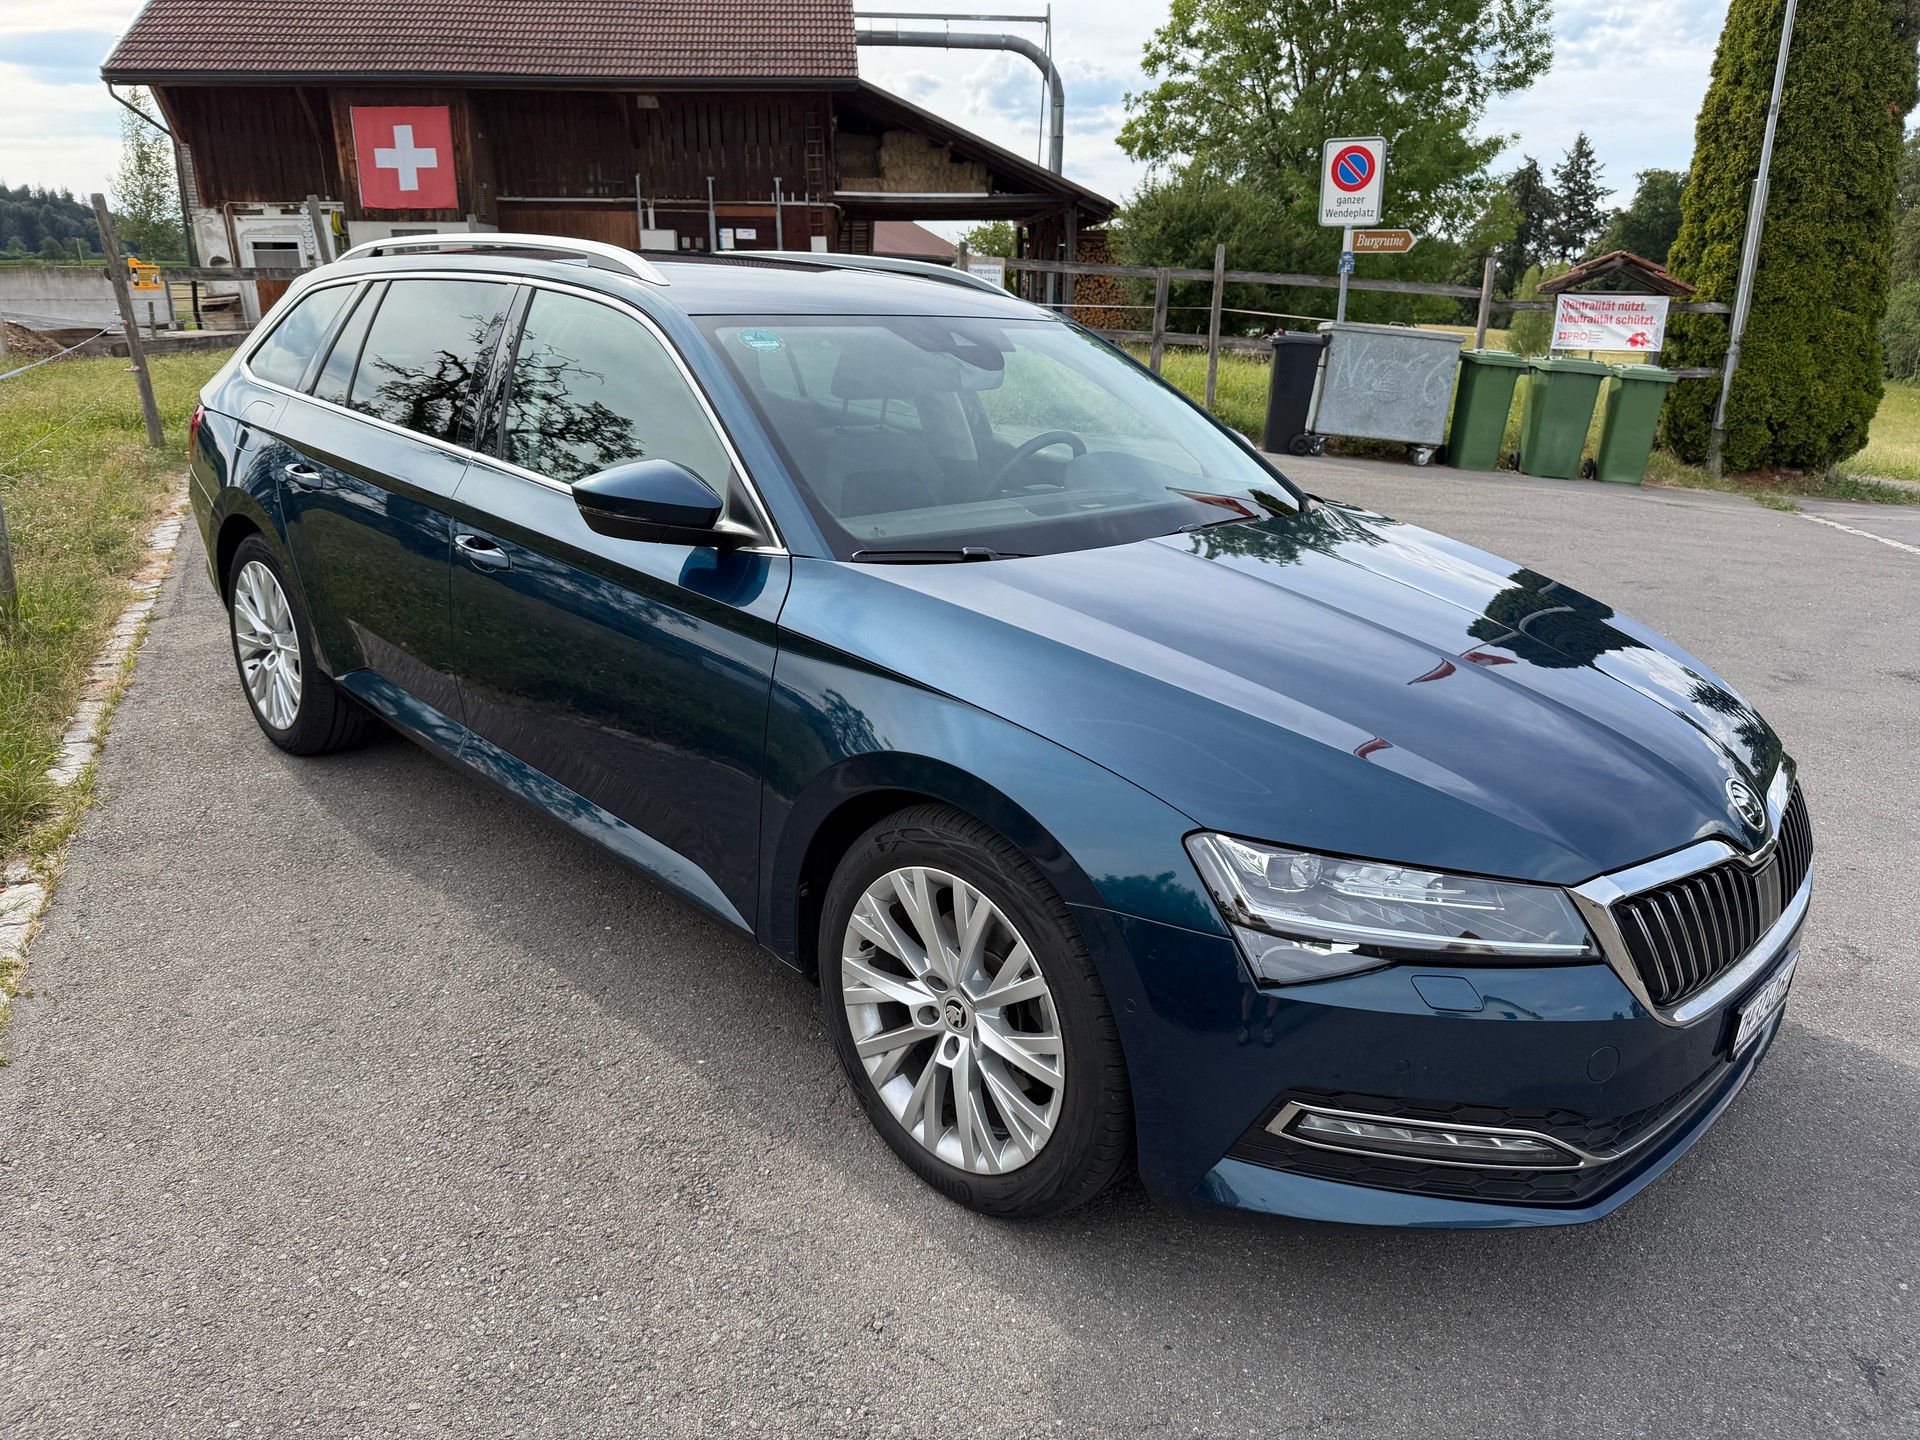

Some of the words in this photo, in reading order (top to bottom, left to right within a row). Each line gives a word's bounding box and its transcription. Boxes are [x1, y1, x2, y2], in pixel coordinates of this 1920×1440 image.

[1336, 196, 1365, 206] ganzer
[1325, 208, 1374, 219] Wendeplatz
[1356, 233, 1405, 249] Burgruine
[1562, 300, 1615, 311] Neutralität
[1618, 300, 1647, 311] nützt.
[1560, 313, 1613, 325] Neutralität
[1615, 314, 1656, 326] schützt.
[1567, 331, 1588, 340] PRO
